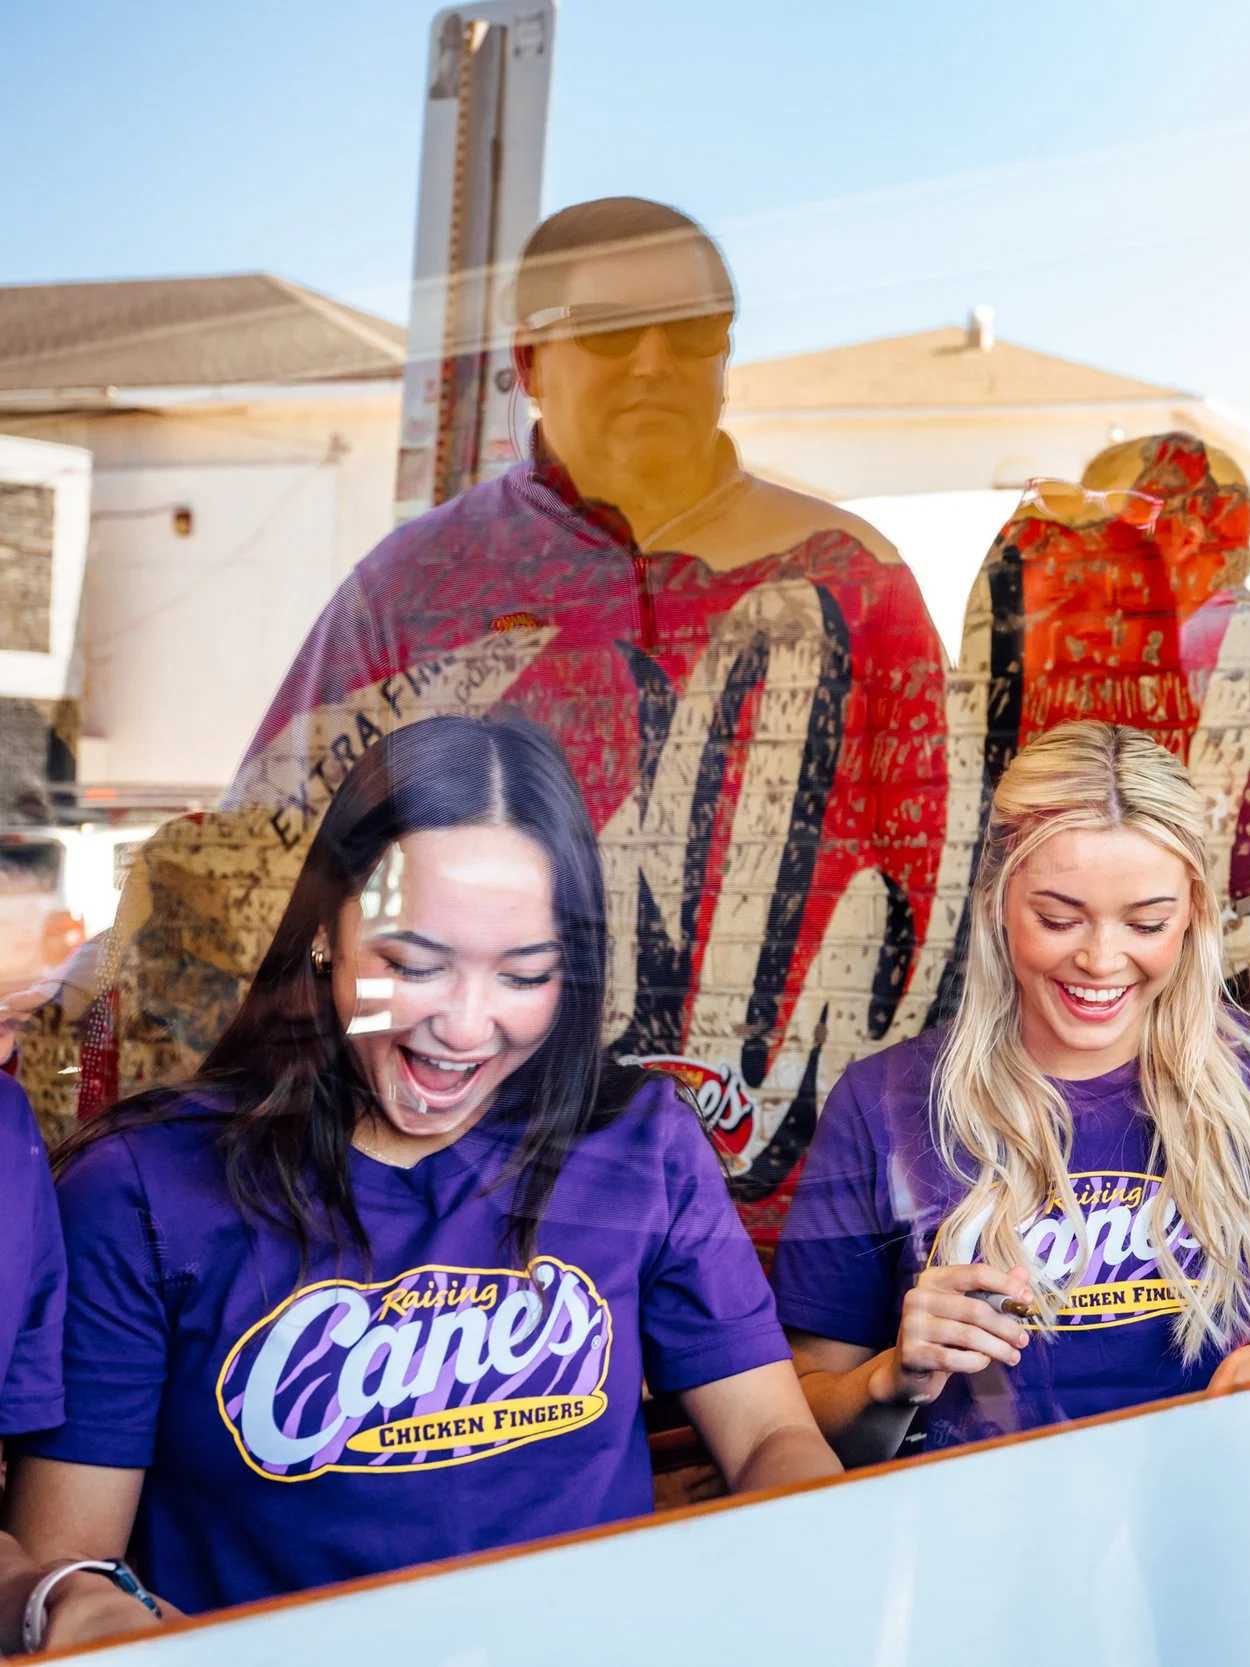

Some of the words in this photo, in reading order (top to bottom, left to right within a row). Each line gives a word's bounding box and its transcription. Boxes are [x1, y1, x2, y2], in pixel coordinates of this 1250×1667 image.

[1045, 1181, 1143, 1214] Rising
[378, 1281, 498, 1321] Raising
[242, 1264, 602, 1465] Cane's
[379, 1415, 484, 1448] CHICKEN
[493, 1399, 585, 1430] FINGERS
